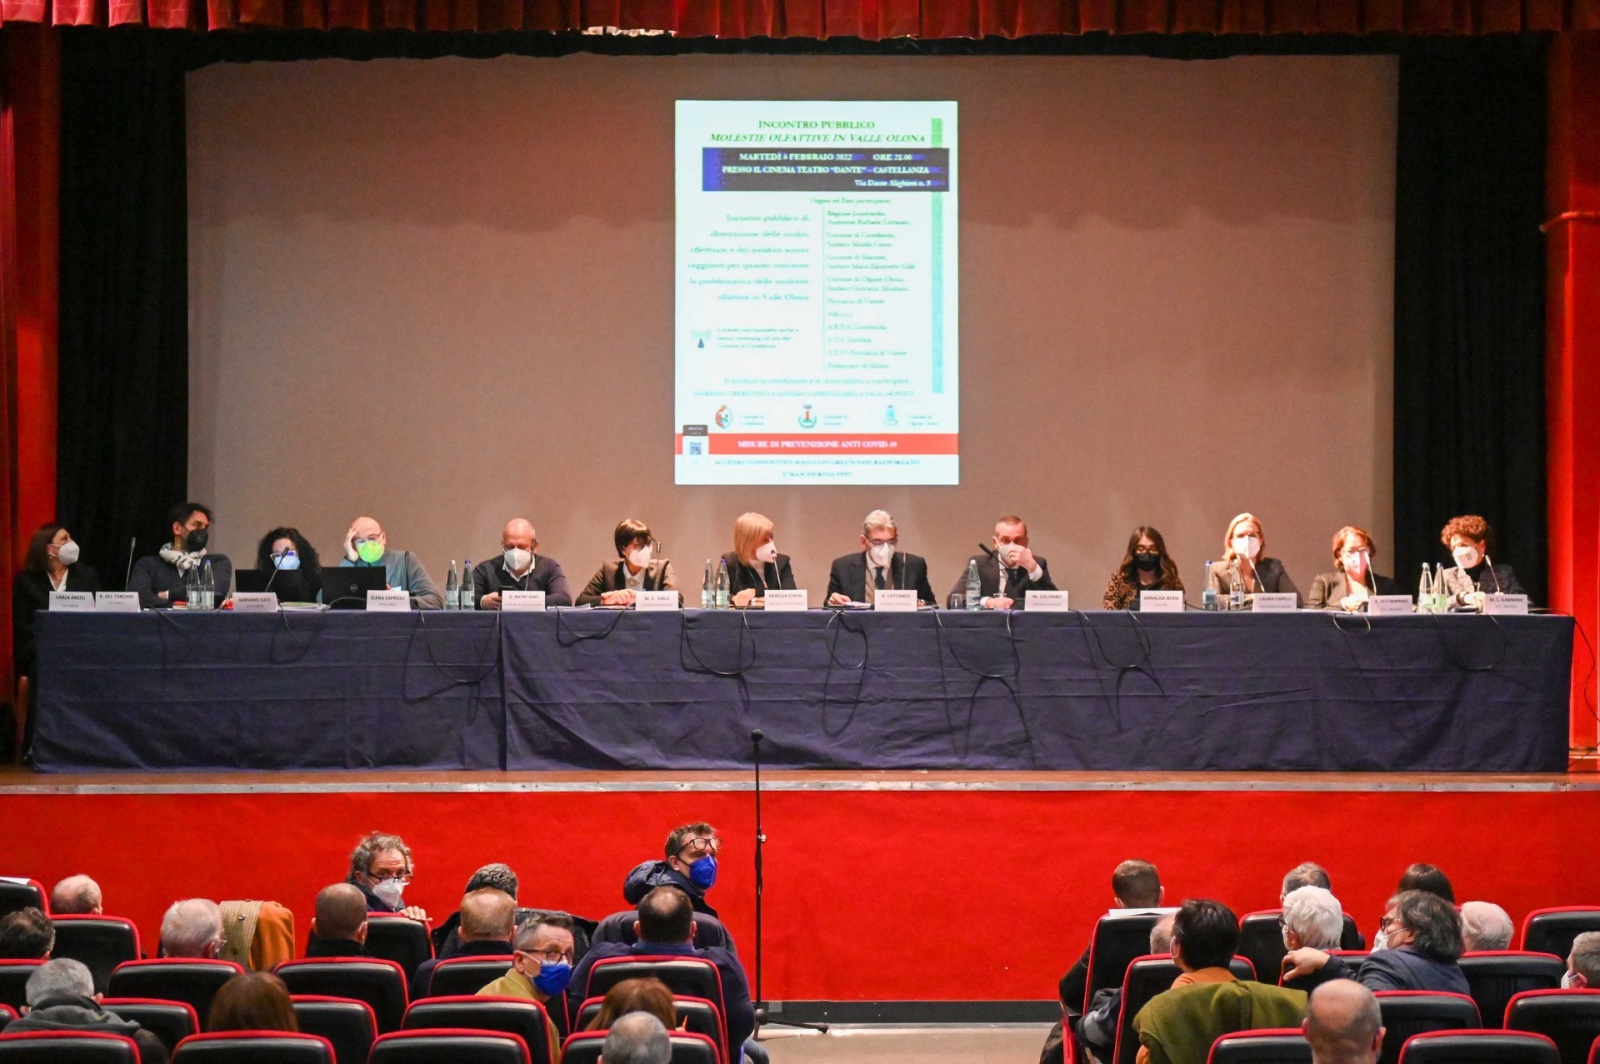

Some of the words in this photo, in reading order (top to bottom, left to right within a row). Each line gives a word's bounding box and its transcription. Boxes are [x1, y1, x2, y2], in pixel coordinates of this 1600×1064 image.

[758, 120, 818, 129] INCONTRO
[821, 120, 875, 129] PUBBLICO
[709, 133, 766, 142] MOLESTIE
[768, 133, 829, 142] OLFATTIVE
[833, 133, 846, 142] IN
[850, 133, 883, 142] VALLE
[886, 133, 925, 142] OLONA
[789, 153, 834, 161] FEBBRAIO
[835, 153, 853, 161] 2022
[873, 153, 892, 161] ORE
[722, 166, 753, 174] PRESSO
[754, 166, 762, 174] IL
[762, 166, 796, 174] CINEMA
[797, 166, 829, 174] TEATRO
[873, 166, 930, 174] CASTELLANZA
[854, 179, 867, 187] Via
[868, 179, 888, 187] Dante
[889, 179, 918, 189] Alighieri
[763, 213, 799, 222] pubblico
[737, 440, 769, 449] MISURE
[770, 440, 780, 449] DI
[781, 440, 839, 449] PREVENZIONE
[841, 440, 862, 449] ANTI
